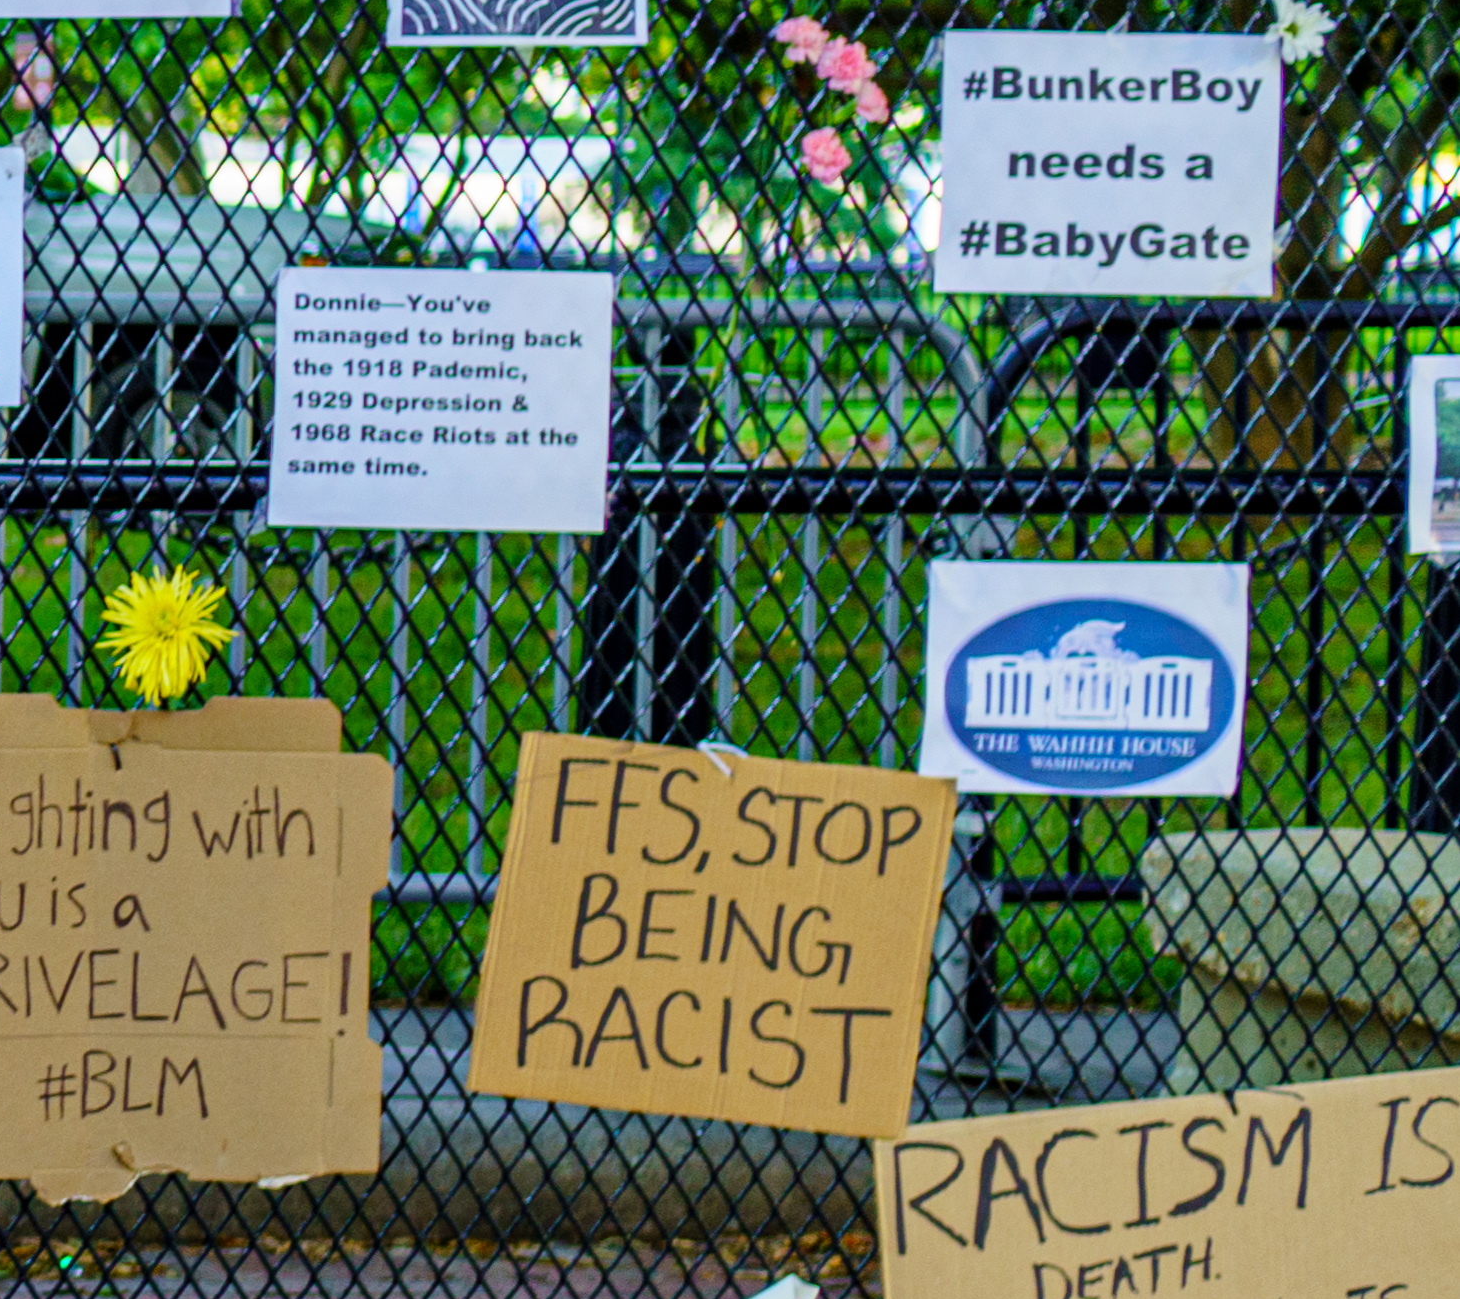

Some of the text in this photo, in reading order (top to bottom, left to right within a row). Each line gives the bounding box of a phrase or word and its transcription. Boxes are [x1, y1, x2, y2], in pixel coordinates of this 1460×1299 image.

[964, 65, 1262, 111] #BunkerBoy
[1007, 144, 1213, 179] needs a
[960, 221, 1249, 267] #BabyGate
[294, 328, 582, 351] managed to bring back
[293, 359, 528, 383] the 1918 Pademic,
[294, 391, 529, 414] 1929 Depression &
[291, 424, 578, 446] 1968 Race Riots at the
[288, 458, 428, 476] same time.
[974, 733, 1196, 757] THE WAHHH HOUSE
[1031, 756, 1134, 772] WASHINGTON
[193, 785, 316, 860] with
[550, 755, 922, 877] FFS, STOP
[48, 876, 88, 929] is
[112, 892, 152, 931] a
[570, 873, 851, 983] BEING
[515, 975, 891, 1106] RACIST
[38, 1050, 209, 1121] #BLM
[893, 1096, 1460, 1255] RACISM IS
